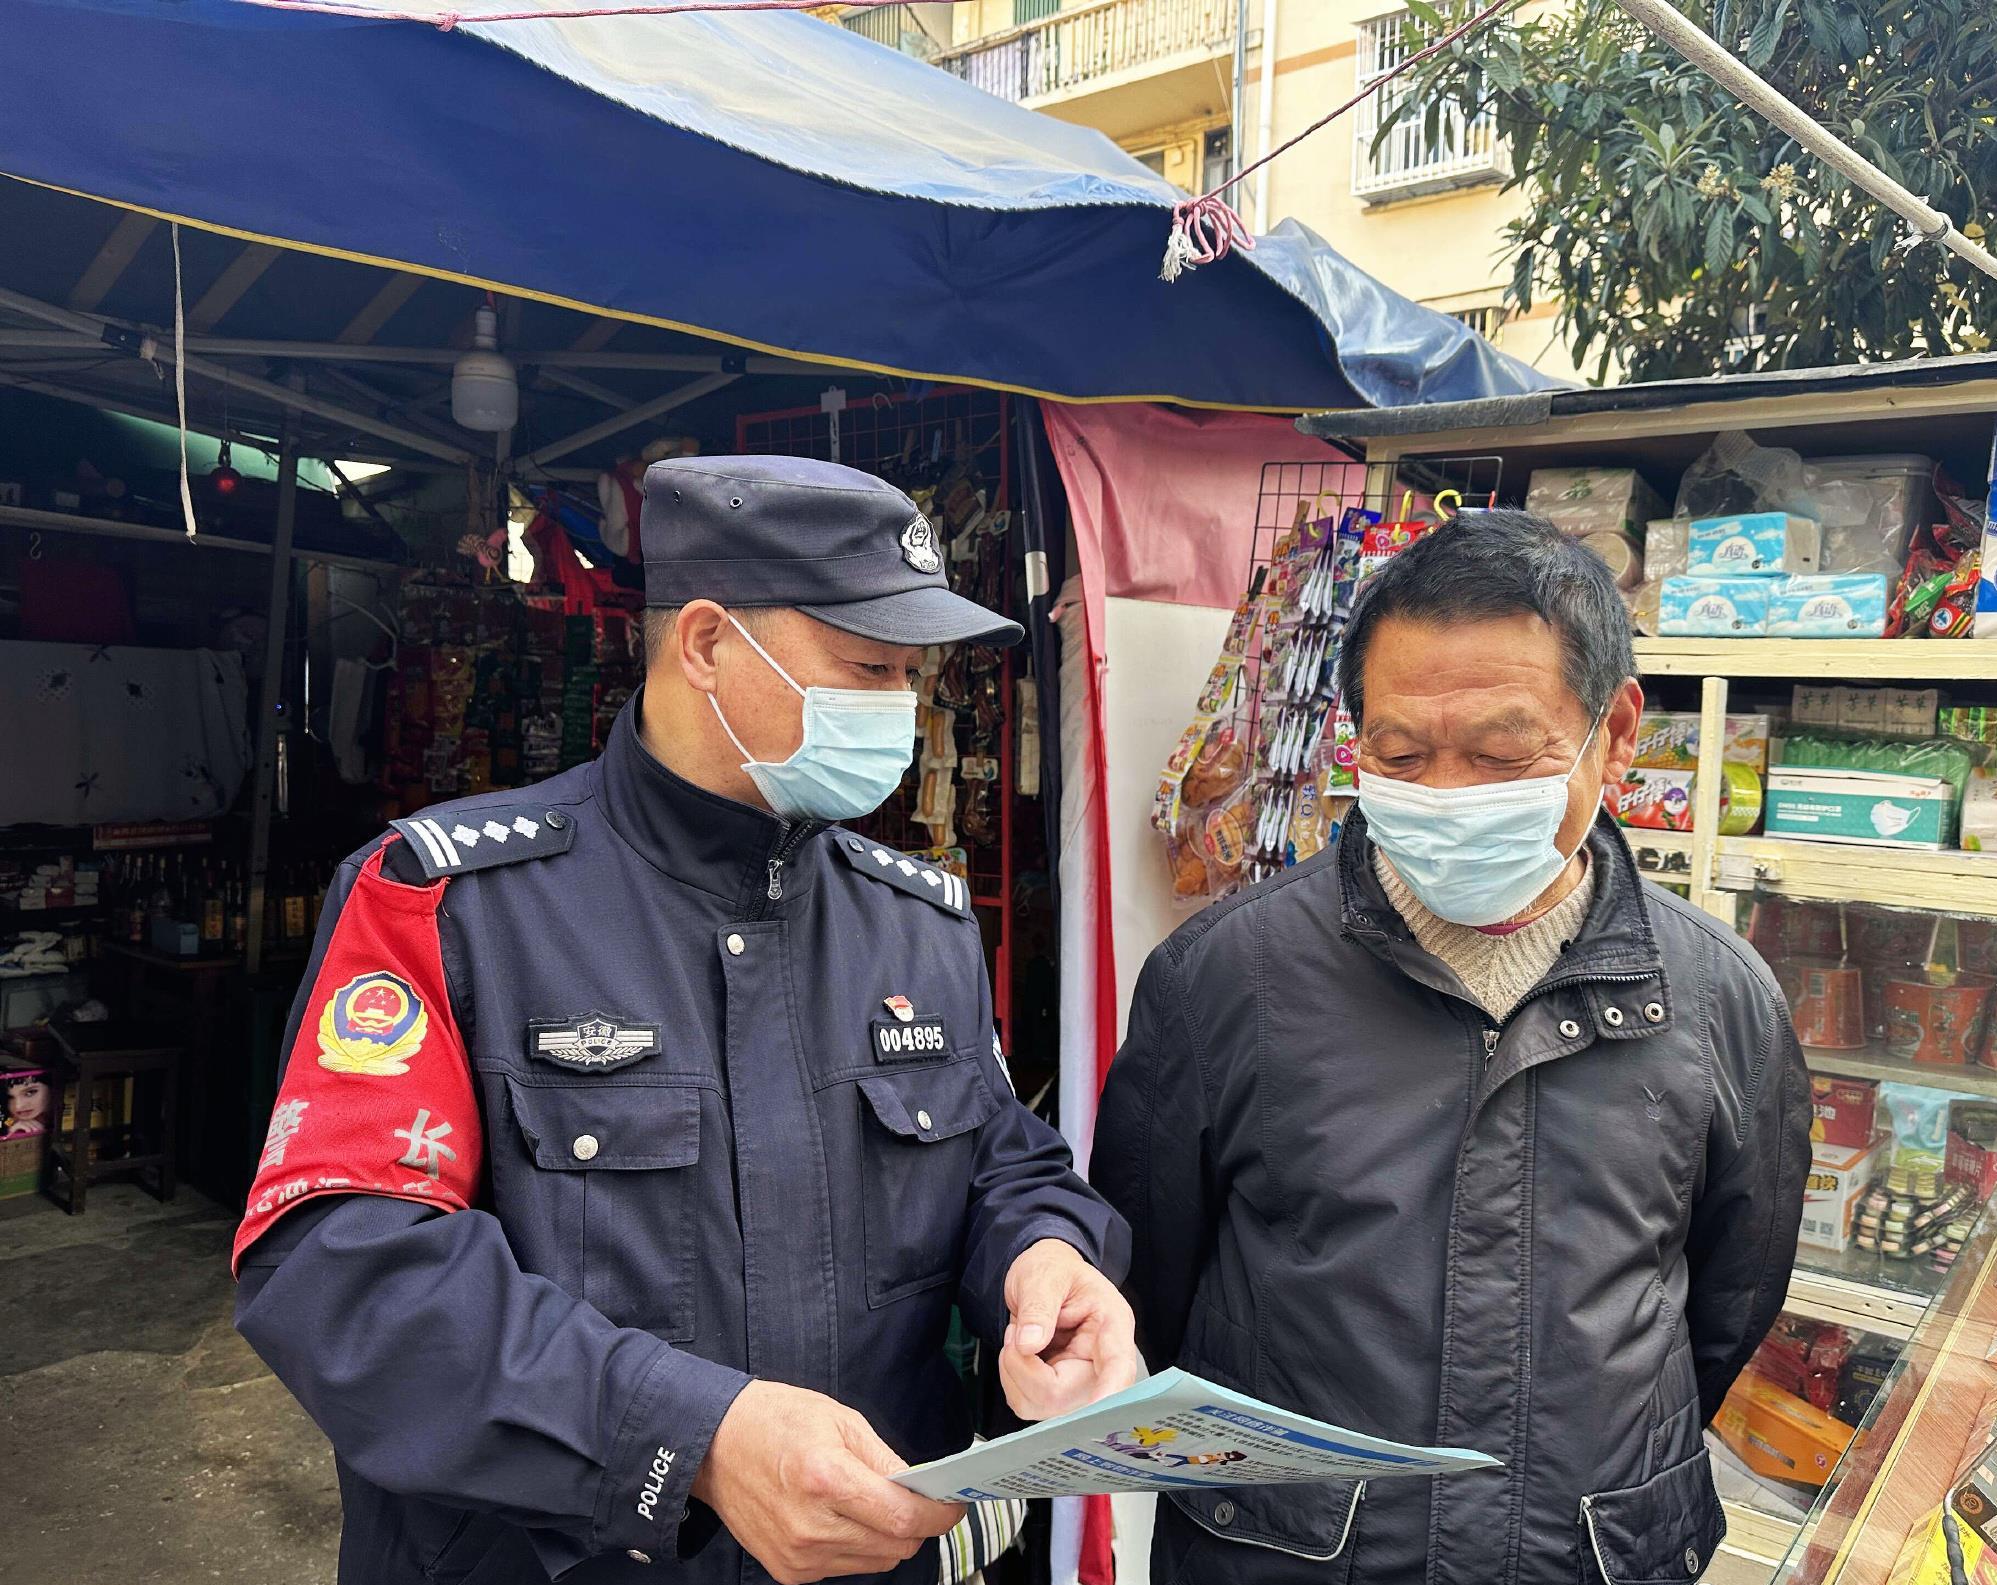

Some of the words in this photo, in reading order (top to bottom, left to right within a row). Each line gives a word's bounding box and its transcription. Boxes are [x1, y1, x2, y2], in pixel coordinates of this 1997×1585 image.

[582, 1025, 613, 1038] 安徽
[879, 1026, 944, 1052] 004895
[580, 1036, 612, 1047] POLICE
[637, 1446, 676, 1521] POLICE
